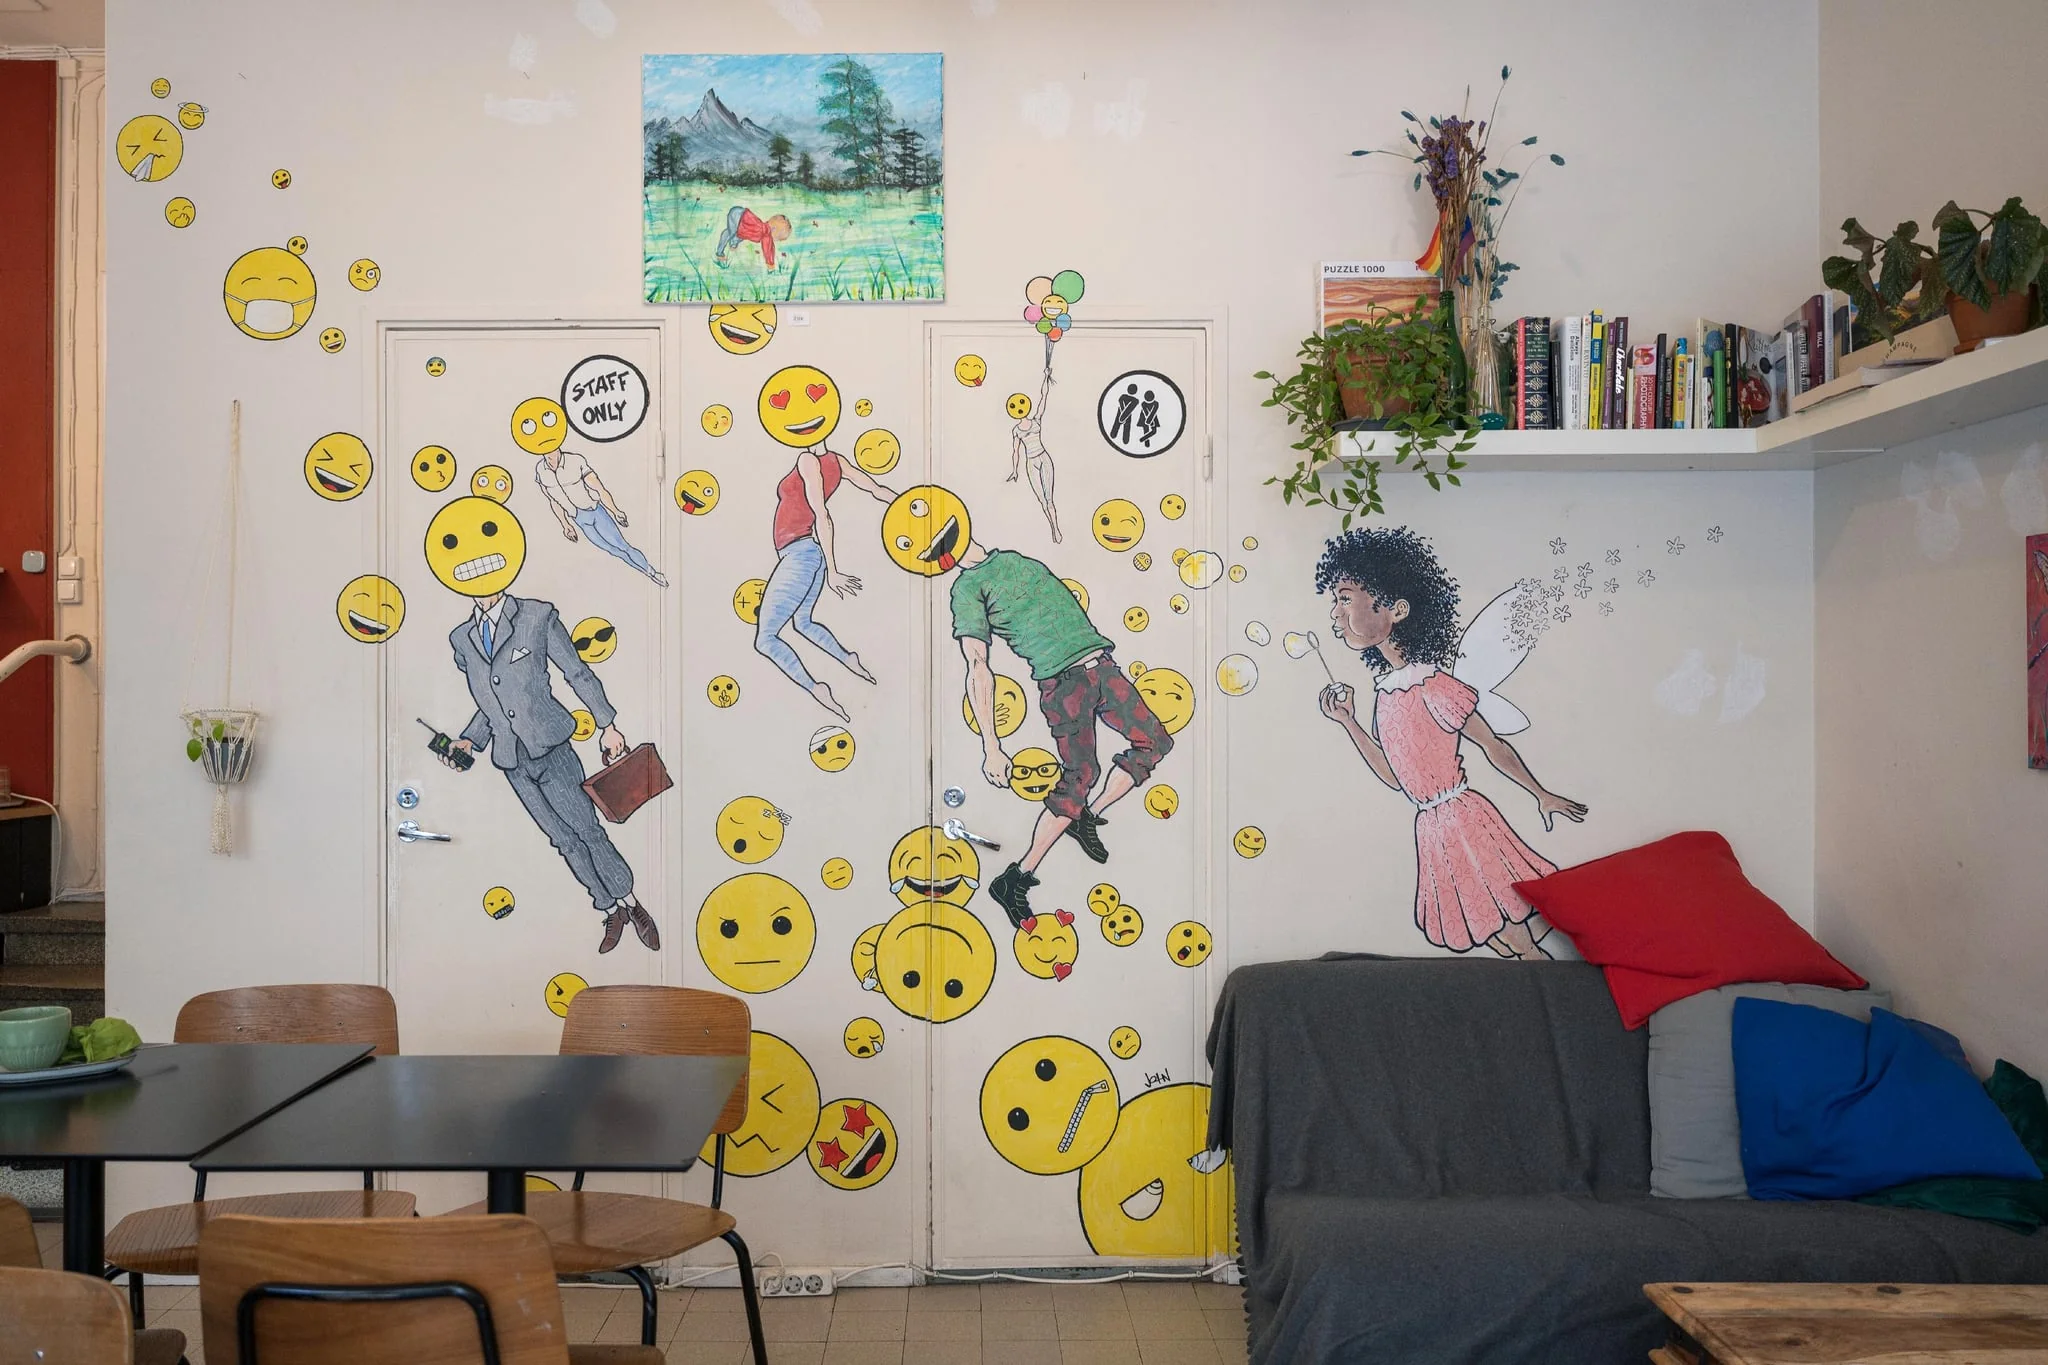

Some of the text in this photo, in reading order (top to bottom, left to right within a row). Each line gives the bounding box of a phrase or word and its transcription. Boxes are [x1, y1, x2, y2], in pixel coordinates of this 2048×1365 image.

[1324, 265, 1386, 273] PUZZLE 1000
[1615, 347, 1625, 394] Chocolate
[572, 370, 630, 402] STAFF
[582, 399, 627, 425] ONLY
